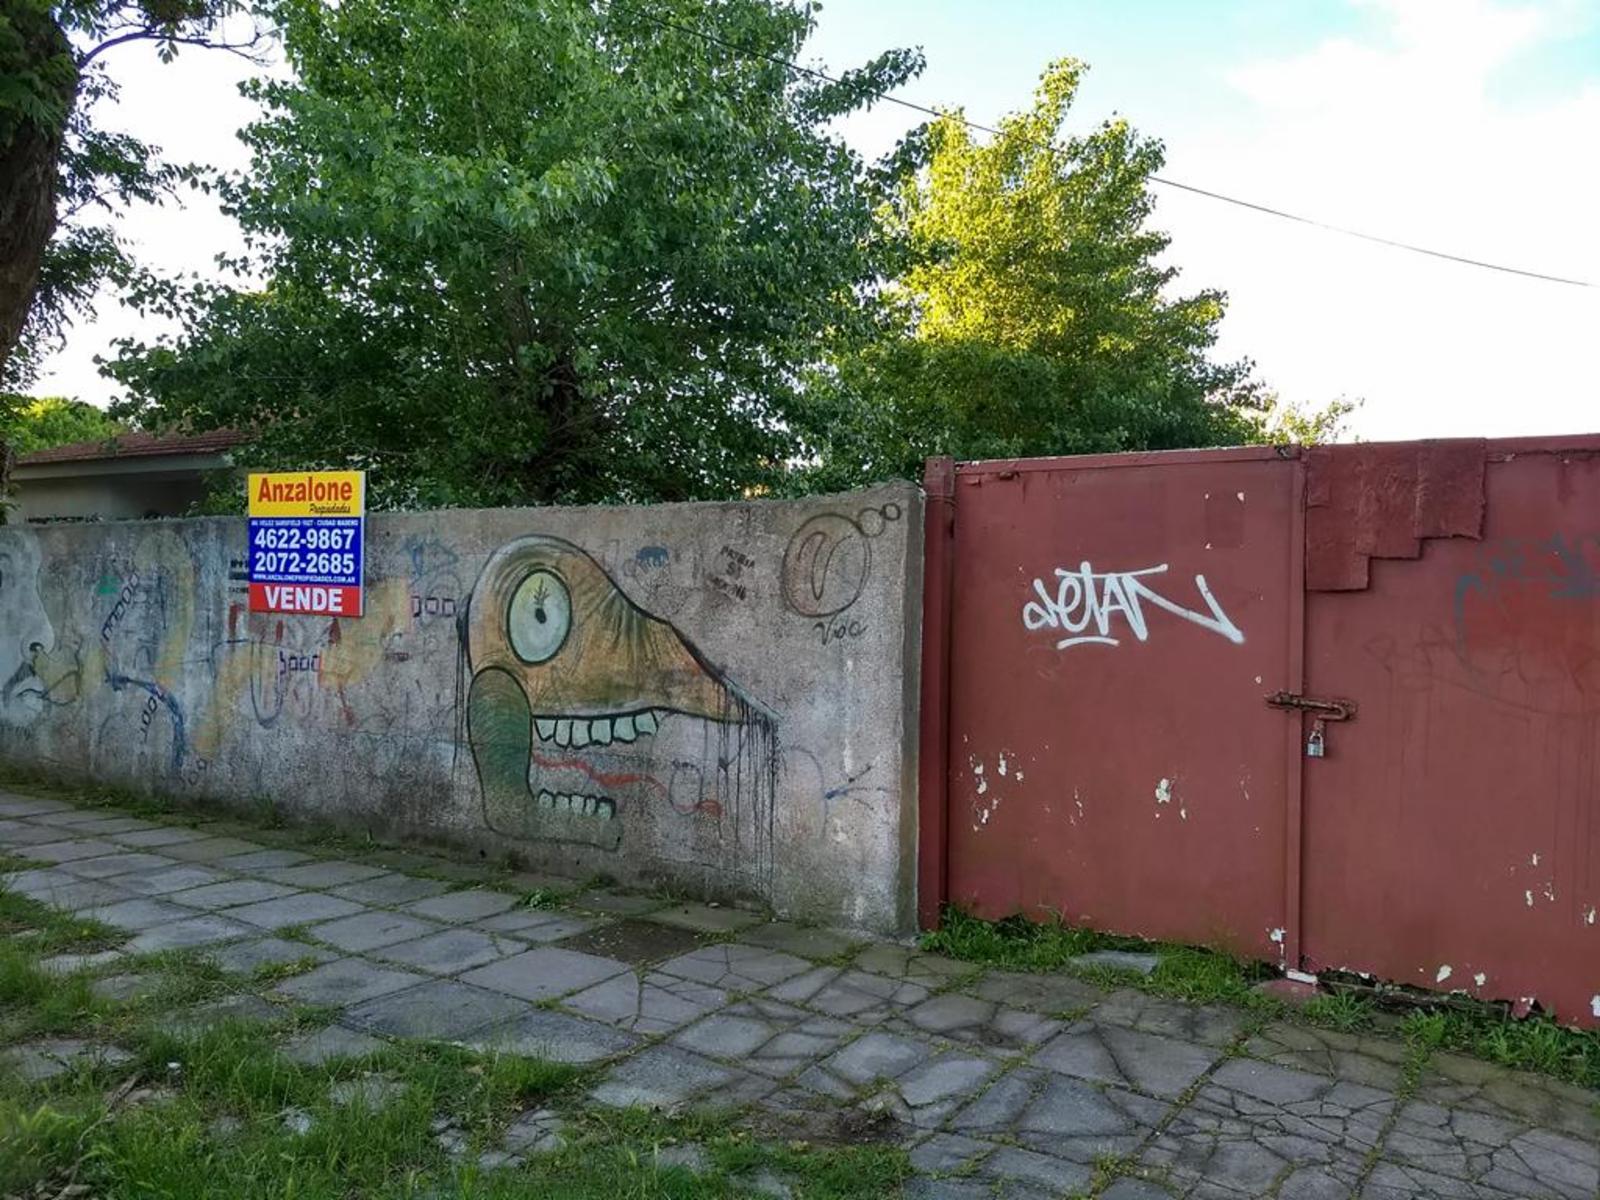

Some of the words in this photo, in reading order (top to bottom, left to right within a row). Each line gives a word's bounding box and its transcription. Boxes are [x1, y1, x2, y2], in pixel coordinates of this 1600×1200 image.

[257, 477, 352, 502] Anzalone
[254, 528, 355, 549] 4622-9867
[255, 552, 354, 574] 2072-2685
[264, 586, 343, 612] VENDE
